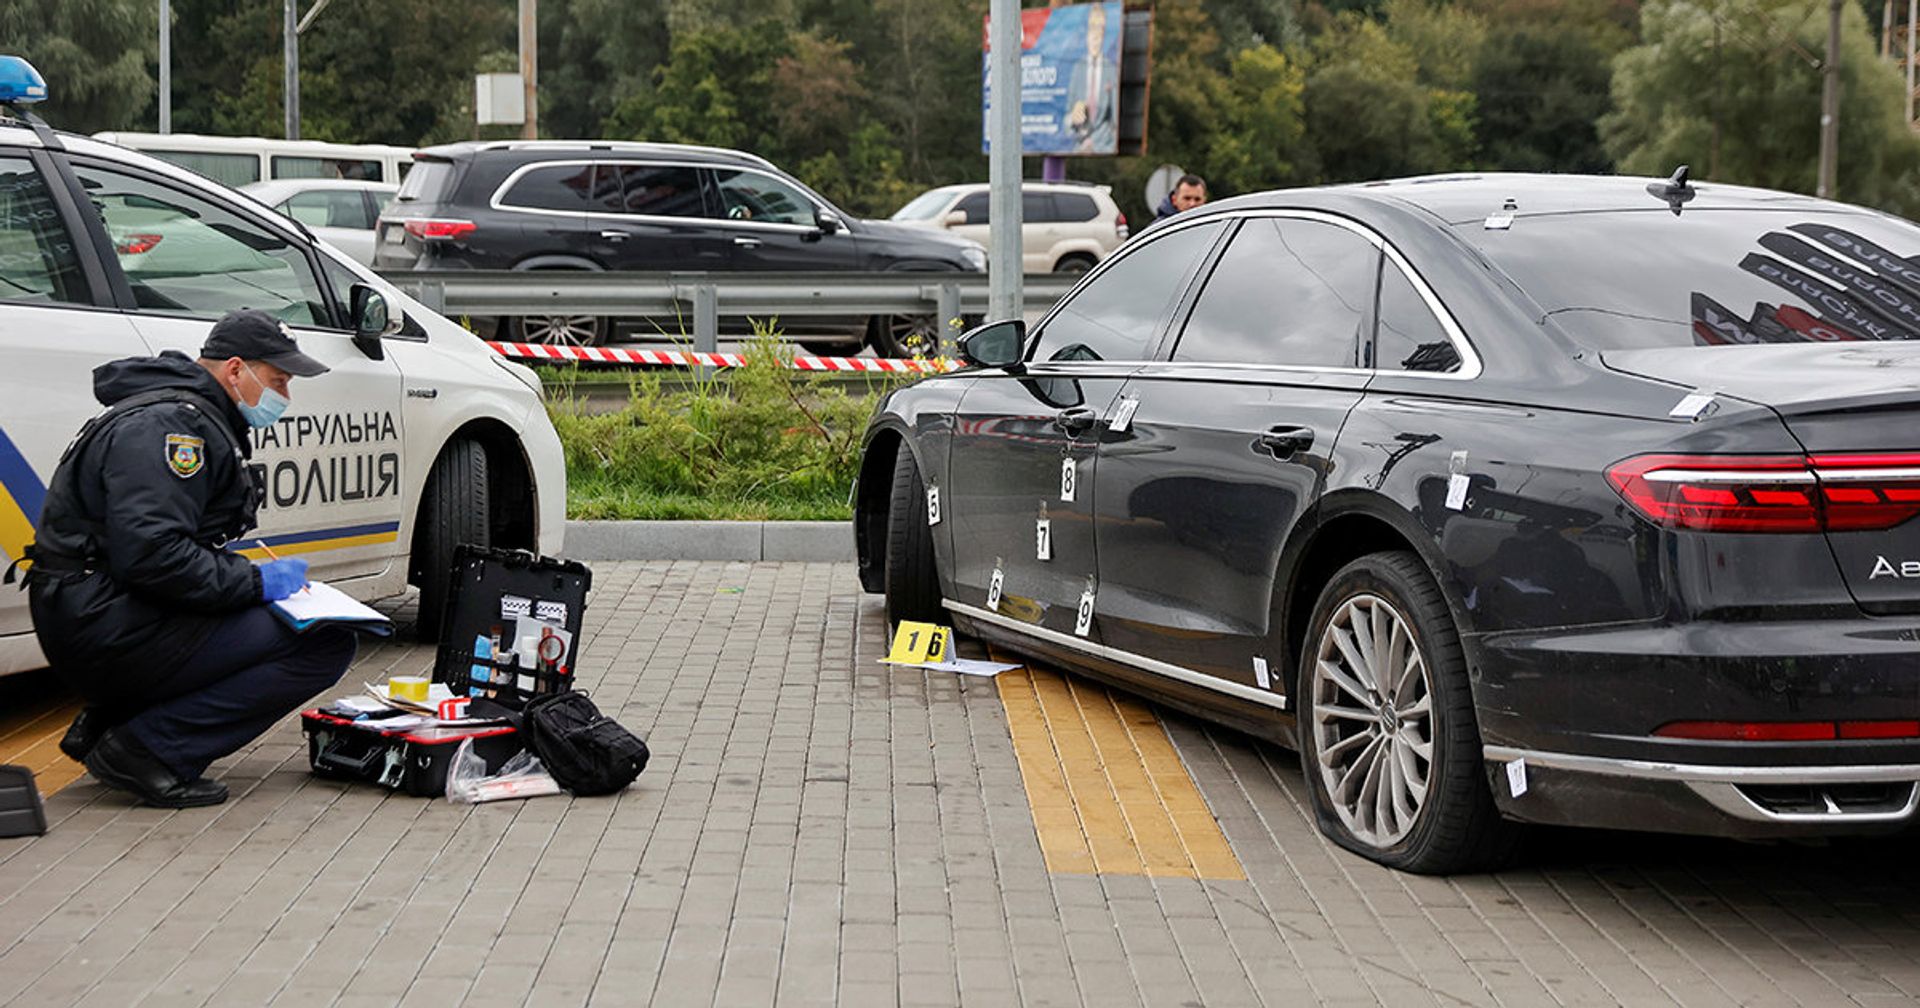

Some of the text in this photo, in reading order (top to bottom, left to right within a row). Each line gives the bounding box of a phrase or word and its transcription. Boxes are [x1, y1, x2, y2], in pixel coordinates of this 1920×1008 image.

[1064, 466, 1073, 493] 8
[931, 494, 938, 518] 5
[1040, 526, 1047, 552] 7
[1868, 554, 1920, 580] A8
[991, 578, 1000, 602] 6
[1080, 601, 1090, 628] 9
